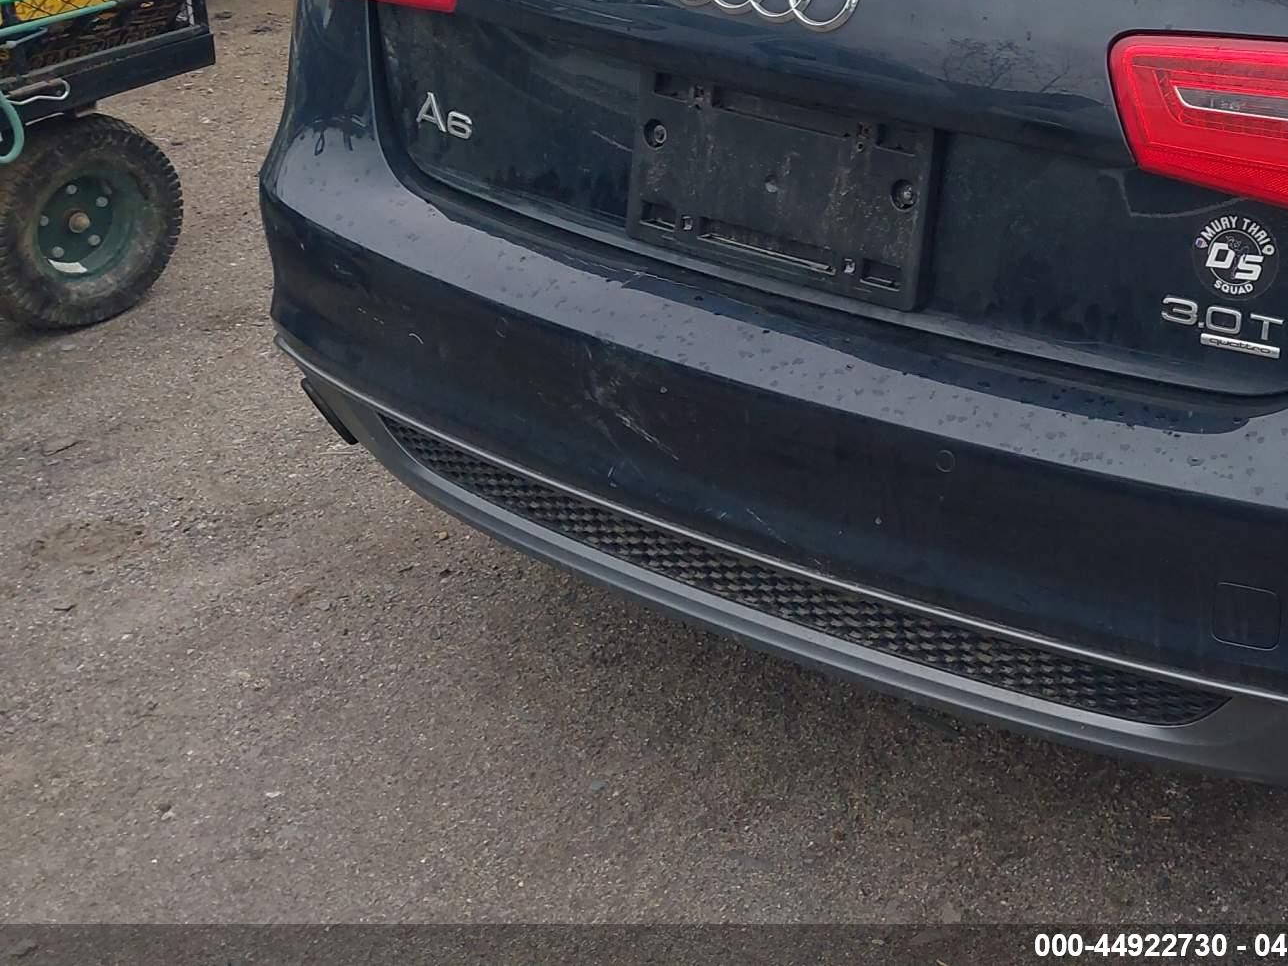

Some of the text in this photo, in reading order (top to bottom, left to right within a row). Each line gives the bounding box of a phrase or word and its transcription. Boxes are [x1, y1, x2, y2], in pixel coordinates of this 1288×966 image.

[416, 91, 473, 140] A6
[1200, 215, 1271, 246] MUAY THAI
[1213, 280, 1254, 295] SQUAD
[1208, 337, 1271, 355] quattro
